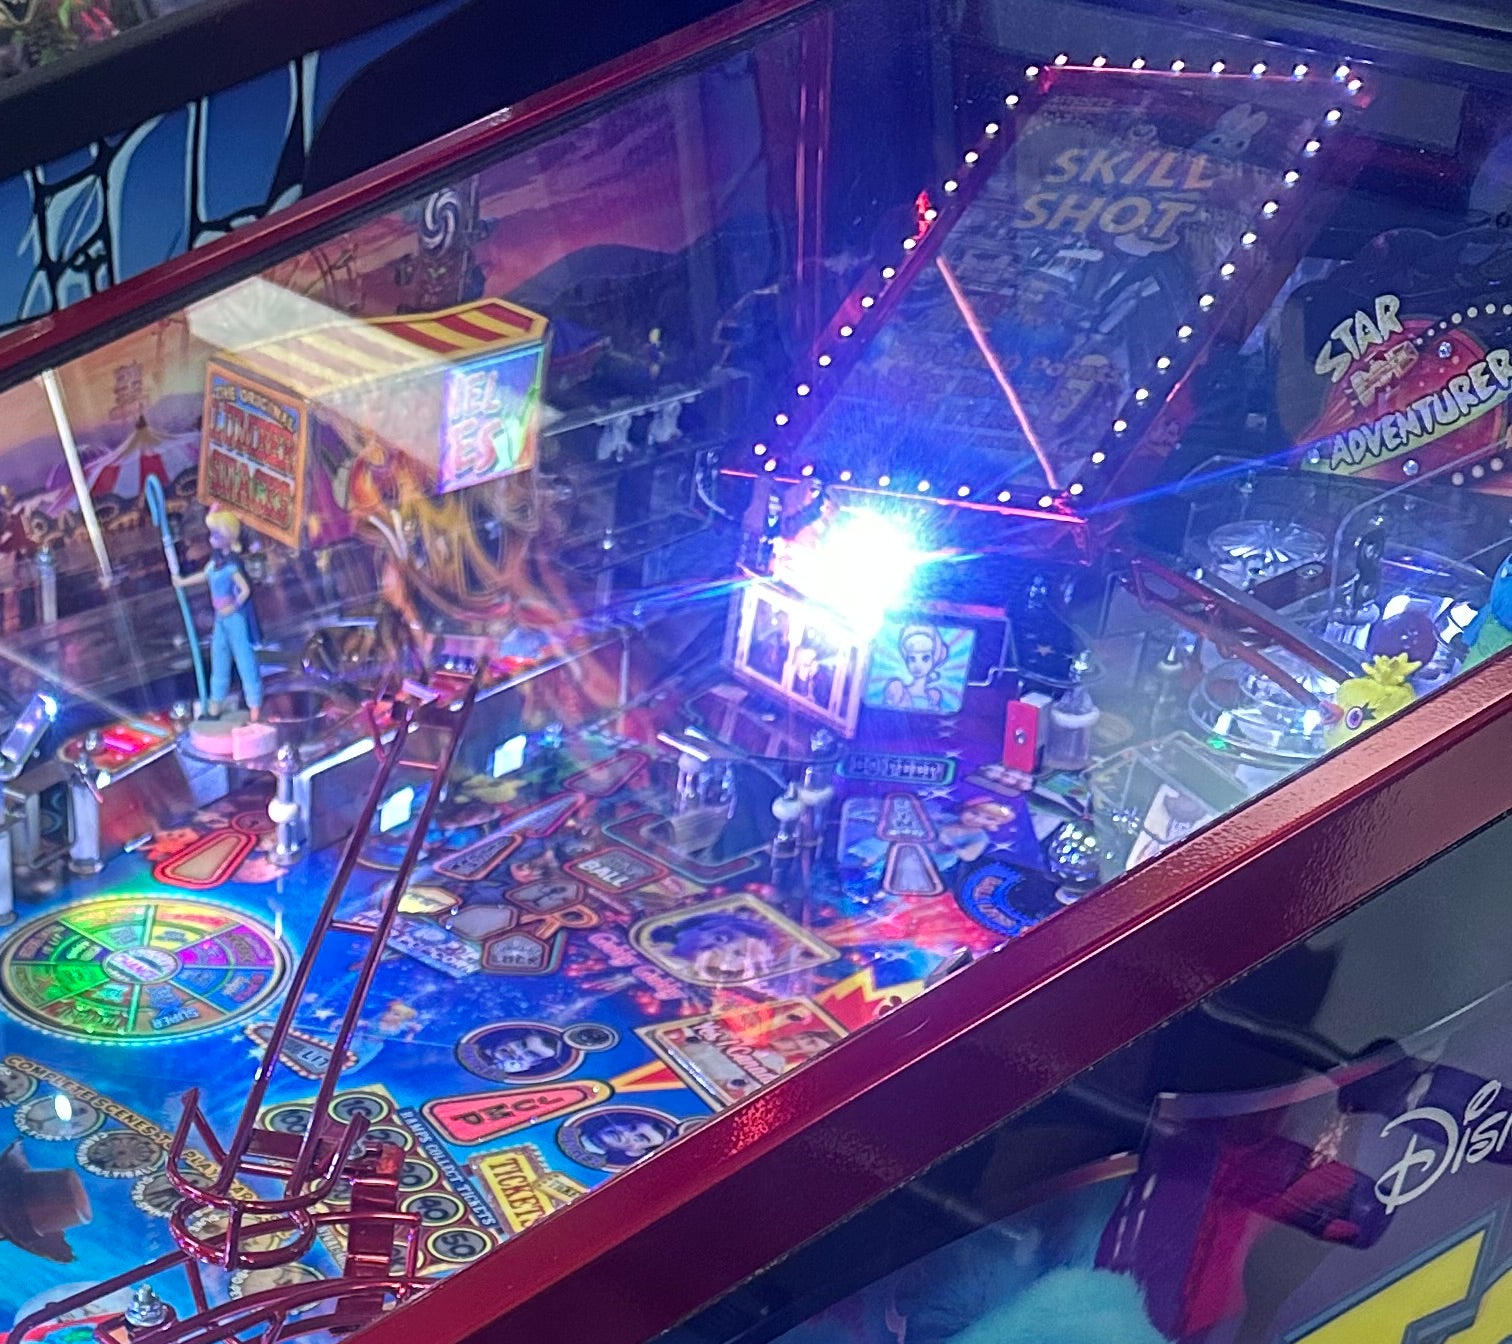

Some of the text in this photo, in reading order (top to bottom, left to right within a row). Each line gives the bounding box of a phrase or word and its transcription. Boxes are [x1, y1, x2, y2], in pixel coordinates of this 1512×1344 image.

[1043, 148, 1215, 190] SKILL
[1013, 191, 1196, 238] SHOT
[1314, 294, 1404, 384] STAR
[1329, 347, 1512, 471] ADVENTURER
[576, 858, 630, 887] BALL
[5, 1055, 96, 1101] COMPLETE
[93, 1097, 160, 1139] SCENES
[398, 1109, 498, 1227] RAMPS COLLECT TICKETS
[414, 1199, 449, 1221] 40
[442, 1232, 479, 1258] 50
